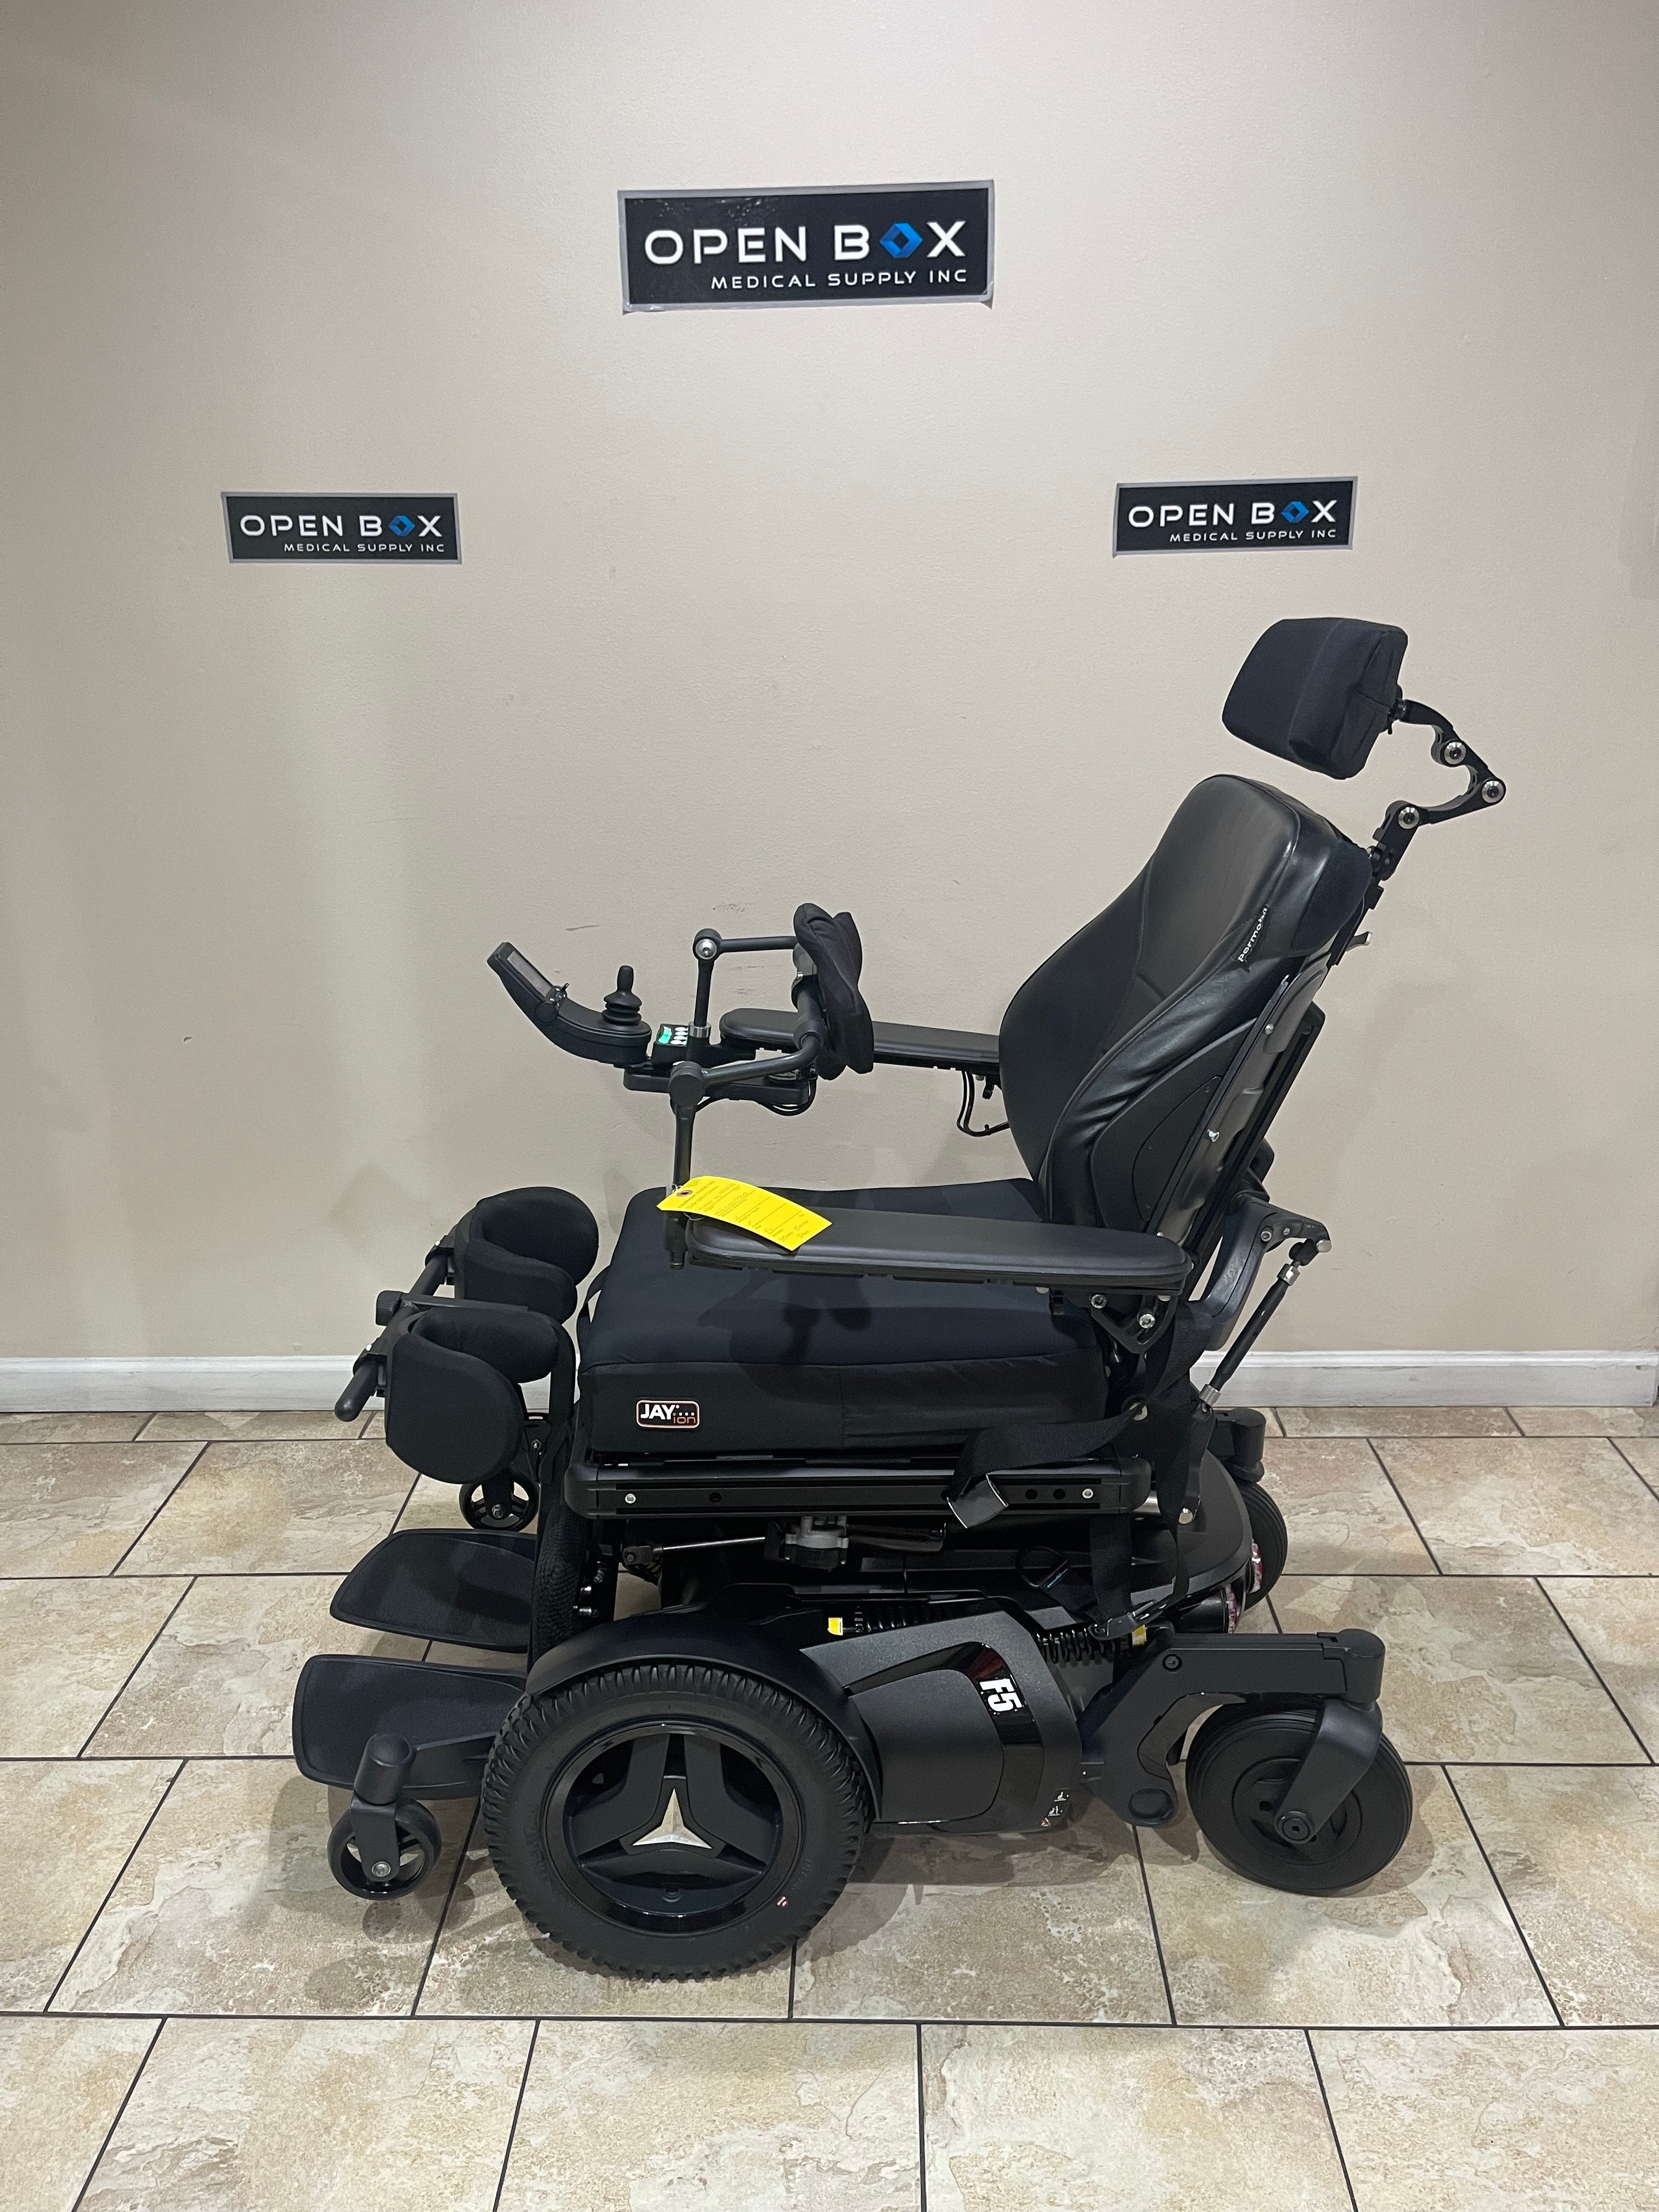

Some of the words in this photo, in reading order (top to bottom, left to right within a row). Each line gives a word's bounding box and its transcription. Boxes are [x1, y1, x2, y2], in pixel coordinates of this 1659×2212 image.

[645, 224, 806, 264] OPEN
[834, 221, 966, 261] BOX
[711, 274, 816, 290] MEDICAL
[827, 270, 916, 286] SUPPLY
[929, 269, 967, 283] INC
[1128, 503, 1234, 527] OPEN
[1251, 500, 1337, 524] BOX
[240, 515, 343, 537] OPEN
[359, 514, 442, 537] BOX
[1170, 532, 1238, 542] MEDICAL
[1245, 530, 1304, 540] SUPPLY
[1311, 529, 1336, 538] INC
[284, 543, 350, 552] MEDICAL
[357, 543, 413, 552] SUPPLY
[421, 544, 444, 552] INC
[640, 1403, 675, 1420] JAY
[673, 1412, 696, 1424] ion
[979, 1678, 1022, 1712] F5
